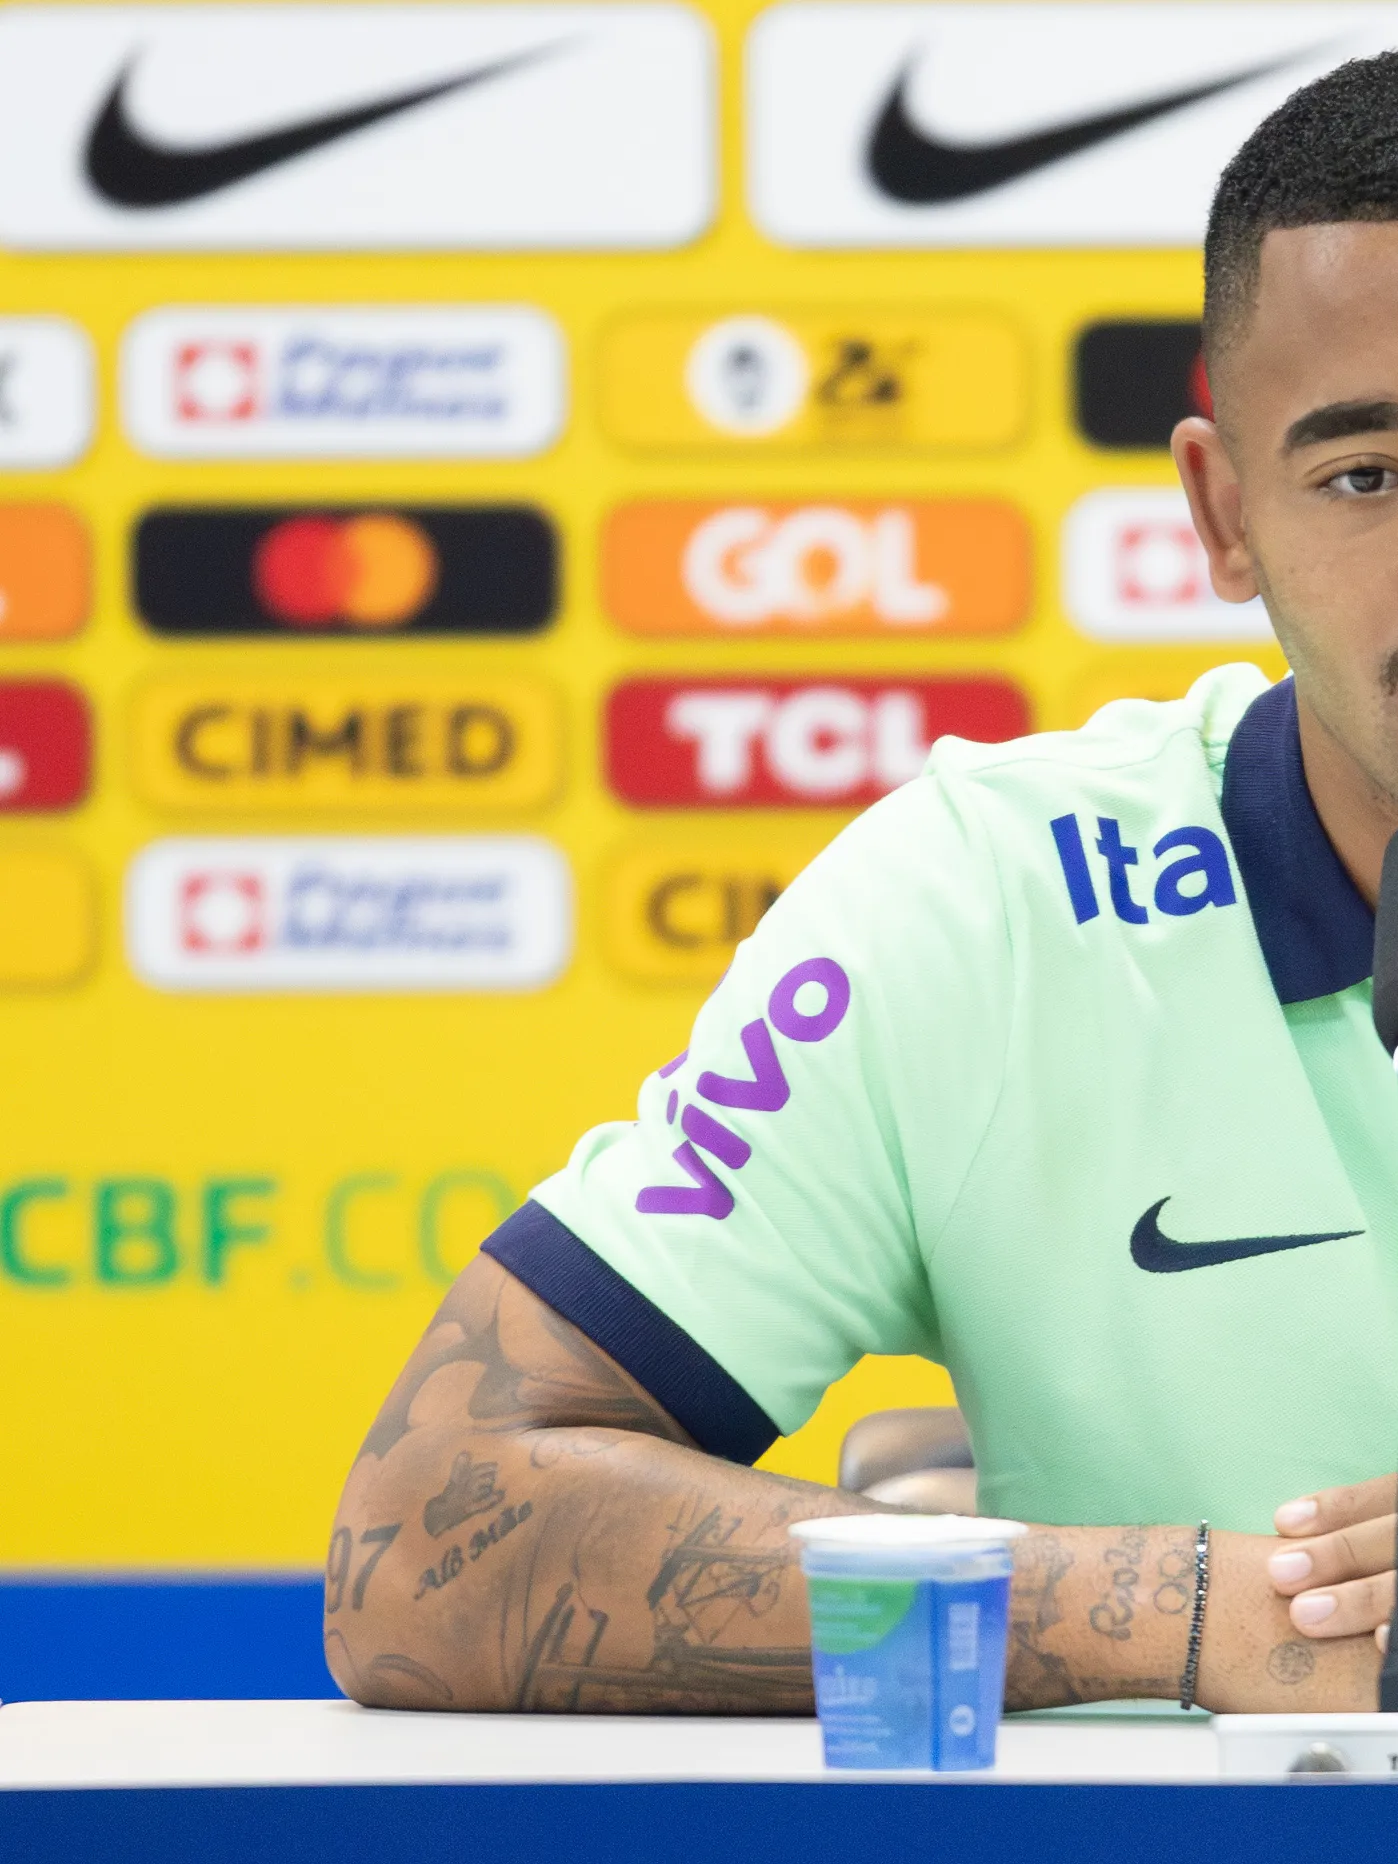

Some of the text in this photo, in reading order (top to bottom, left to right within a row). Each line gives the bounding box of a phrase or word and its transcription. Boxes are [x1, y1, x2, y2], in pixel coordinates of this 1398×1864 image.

[682, 507, 948, 625] GOL
[172, 702, 516, 782] CIMED
[664, 688, 934, 796] TCL
[1049, 812, 1237, 927] Ita
[635, 957, 851, 1220] vivo
[326, 1522, 403, 1614] 97
